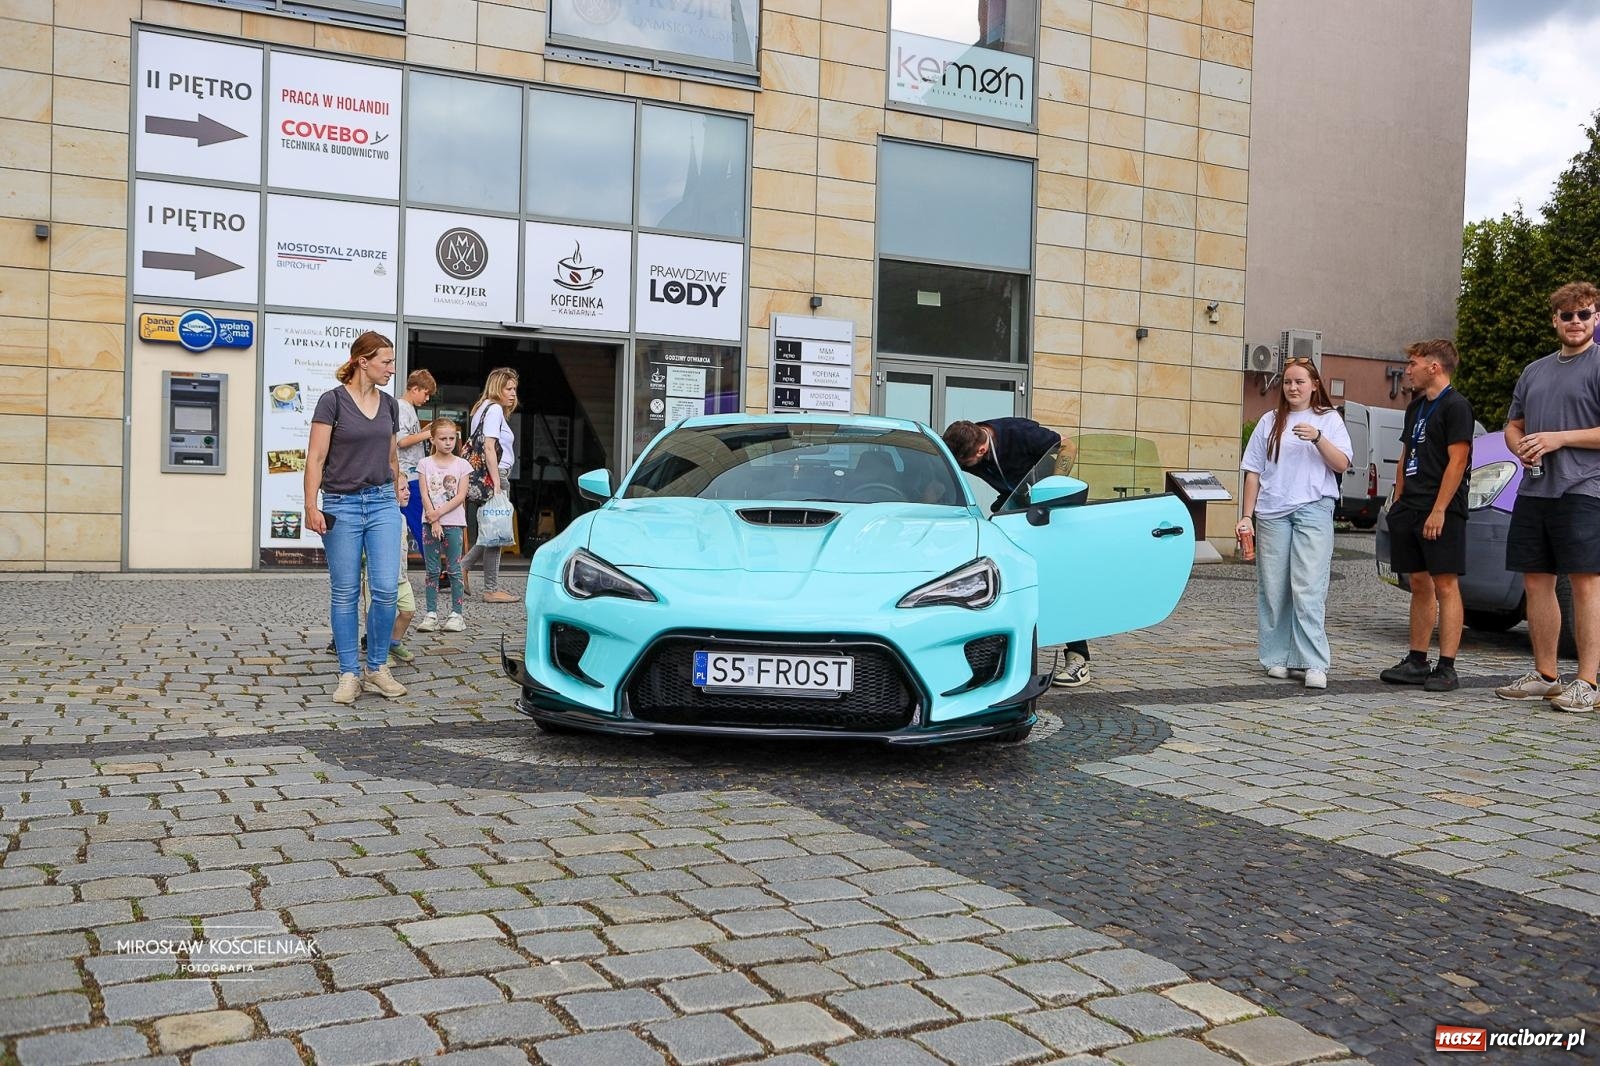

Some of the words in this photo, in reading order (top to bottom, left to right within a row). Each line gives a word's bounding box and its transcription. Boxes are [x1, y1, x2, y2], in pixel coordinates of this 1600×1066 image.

[146, 70, 160, 89] II
[169, 72, 252, 101] PIĘTRO
[282, 88, 319, 108] PRACA
[322, 94, 334, 108] W
[337, 96, 389, 116] HOLANDII
[281, 120, 369, 144] COVEBO
[282, 138, 320, 152] TECHNIKA
[322, 144, 329, 154] &
[331, 145, 389, 160] BUDOWNICTWO
[148, 206, 153, 224] I
[162, 207, 246, 232] PIĘTRO
[277, 242, 344, 256] MOSTOSTAL
[346, 248, 388, 260] ZABRZE
[650, 264, 727, 284] PRAWDZIWE
[435, 283, 487, 298] FRYZJER
[650, 278, 727, 308] LODY
[550, 294, 604, 310] KOFEINKA
[147, 317, 174, 326] banko
[558, 308, 596, 317] KAWIARNIA
[232, 330, 250, 338] mat
[283, 337, 331, 349] ZAPRASZA
[482, 508, 511, 518] pepco
[696, 672, 706, 680] PL
[712, 656, 745, 683] S5
[758, 658, 848, 687] FROST
